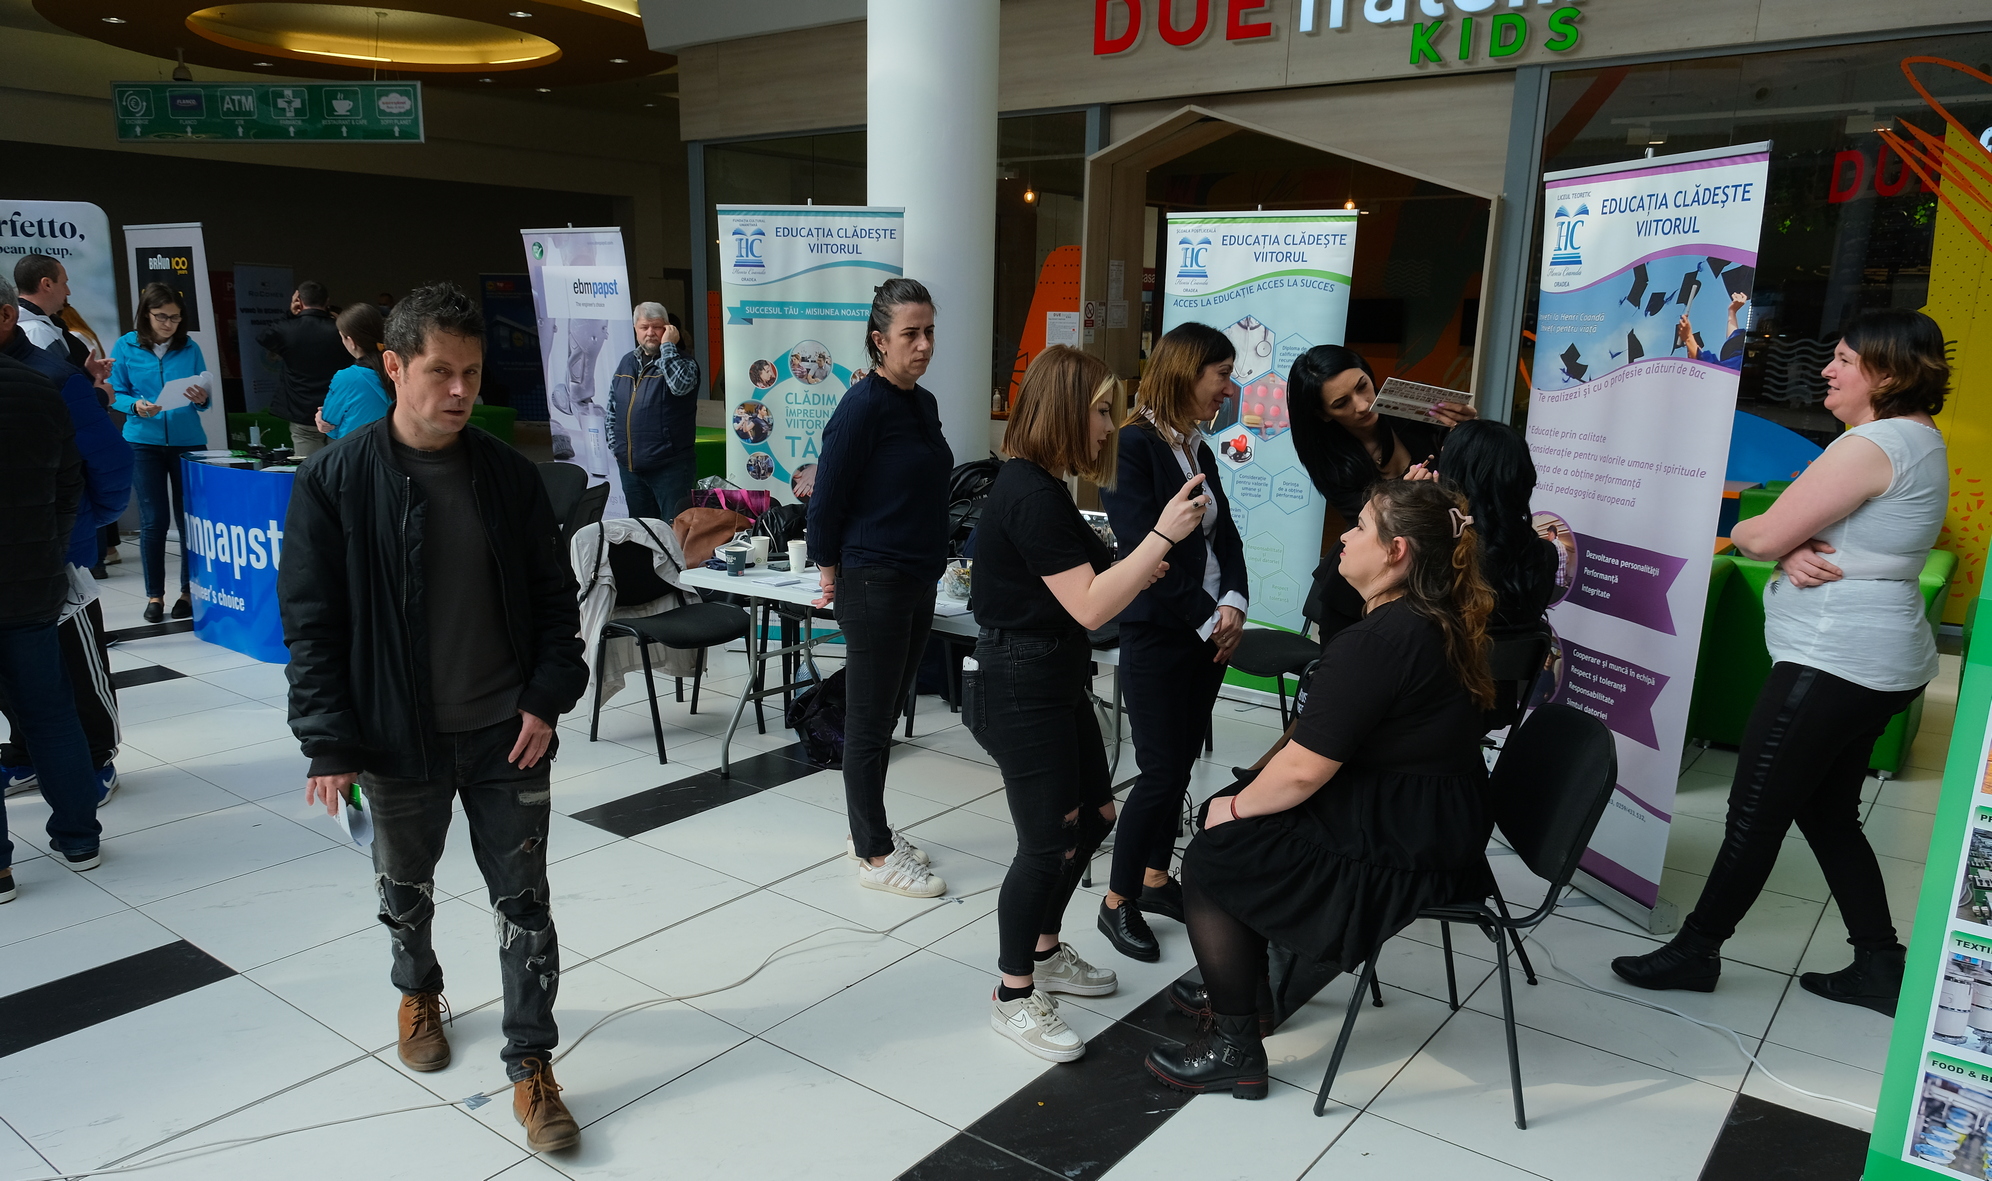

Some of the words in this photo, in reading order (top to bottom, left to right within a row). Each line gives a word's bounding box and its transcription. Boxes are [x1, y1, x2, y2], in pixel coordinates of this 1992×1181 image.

[1409, 7, 1581, 65] KIDS
[223, 95, 254, 112] ATM
[1557, 193, 1571, 201] LICEUL
[1571, 191, 1592, 200] TEORETIC
[1600, 192, 1669, 217] EDUCAȚIA
[1673, 182, 1754, 210] CLĂDEȘTE
[0, 211, 86, 243] rfetto,
[775, 226, 834, 242] EDUCAȚIA
[836, 225, 897, 242] CLĂDEȘTE
[1636, 215, 1701, 238] VIITORUL
[1221, 234, 1280, 249] EDUCAȚIA
[1283, 231, 1348, 249] CLĂDEȘTE
[1553, 220, 1585, 252] HC
[29, 246, 42, 255] to
[45, 247, 73, 259] cup.
[735, 238, 763, 258] HC
[808, 243, 862, 255] VIITORUL
[1253, 251, 1308, 263] VIITORUL
[171, 257, 189, 270] 100
[1180, 247, 1208, 268] HC
[573, 278, 619, 299] ebmpapst
[1172, 298, 1199, 308] ACCES
[1200, 296, 1212, 307] LA
[1213, 287, 1255, 305] EDUCAȚIE
[1256, 279, 1285, 293] ACCES
[1287, 278, 1298, 287] LA
[1300, 279, 1335, 293] SUCCES
[745, 306, 783, 315] SUCCESUL
[783, 305, 799, 315] TĂU
[805, 308, 840, 316] MISIUNEA
[841, 308, 870, 317] NOASTR
[1560, 312, 1578, 321] Henri
[1556, 325, 1578, 334] pentru
[1538, 392, 1547, 403] Te
[1546, 386, 1581, 403] realizezi
[1582, 386, 1591, 399] și
[1592, 383, 1602, 393] cu
[1603, 381, 1609, 389] o
[1610, 366, 1643, 388] profesie
[1645, 362, 1676, 376] alături
[1676, 363, 1688, 376] de
[1688, 366, 1707, 381] Bac
[785, 389, 837, 406] CLĂDIM
[785, 418, 825, 430] VIITOR
[1530, 425, 1560, 439] Educație
[1559, 429, 1577, 440] prin
[1578, 432, 1607, 444] calitate
[785, 430, 822, 459] TĂ
[1529, 443, 1572, 458] Considerație
[1572, 451, 1599, 460] pentru
[1599, 454, 1626, 466] valorile
[1627, 459, 1654, 471] umane
[1655, 461, 1663, 474] și
[1663, 464, 1707, 479] spirituale
[1238, 473, 1267, 481] Considerație
[1534, 462, 1551, 474] rința
[1552, 465, 1562, 475] de
[1570, 468, 1594, 480] obține
[1594, 471, 1642, 490] performanță
[1535, 481, 1554, 492] duită
[1554, 485, 1596, 500] pedagogică
[1596, 493, 1636, 508] europeană
[1585, 549, 1620, 566] Dezvoltarea
[1583, 566, 1619, 584] Performanță
[1271, 584, 1289, 592] Respect
[1581, 583, 1611, 599] Integritate
[217, 588, 246, 612] choice
[1572, 648, 1601, 666] Cooperare
[1601, 658, 1609, 669] și
[1608, 661, 1629, 675] muncă
[1629, 666, 1636, 678] în
[1635, 670, 1656, 686] echipă
[1570, 664, 1592, 680] Respect
[1591, 673, 1599, 683] și
[1598, 675, 1627, 693] toleranță
[1568, 681, 1615, 706] Responsabilitate
[1583, 705, 1609, 721] datoriei
[1955, 938, 1992, 955] TEXTI
[1931, 1059, 1965, 1075] FOOD
[1968, 1070, 1977, 1078] &
